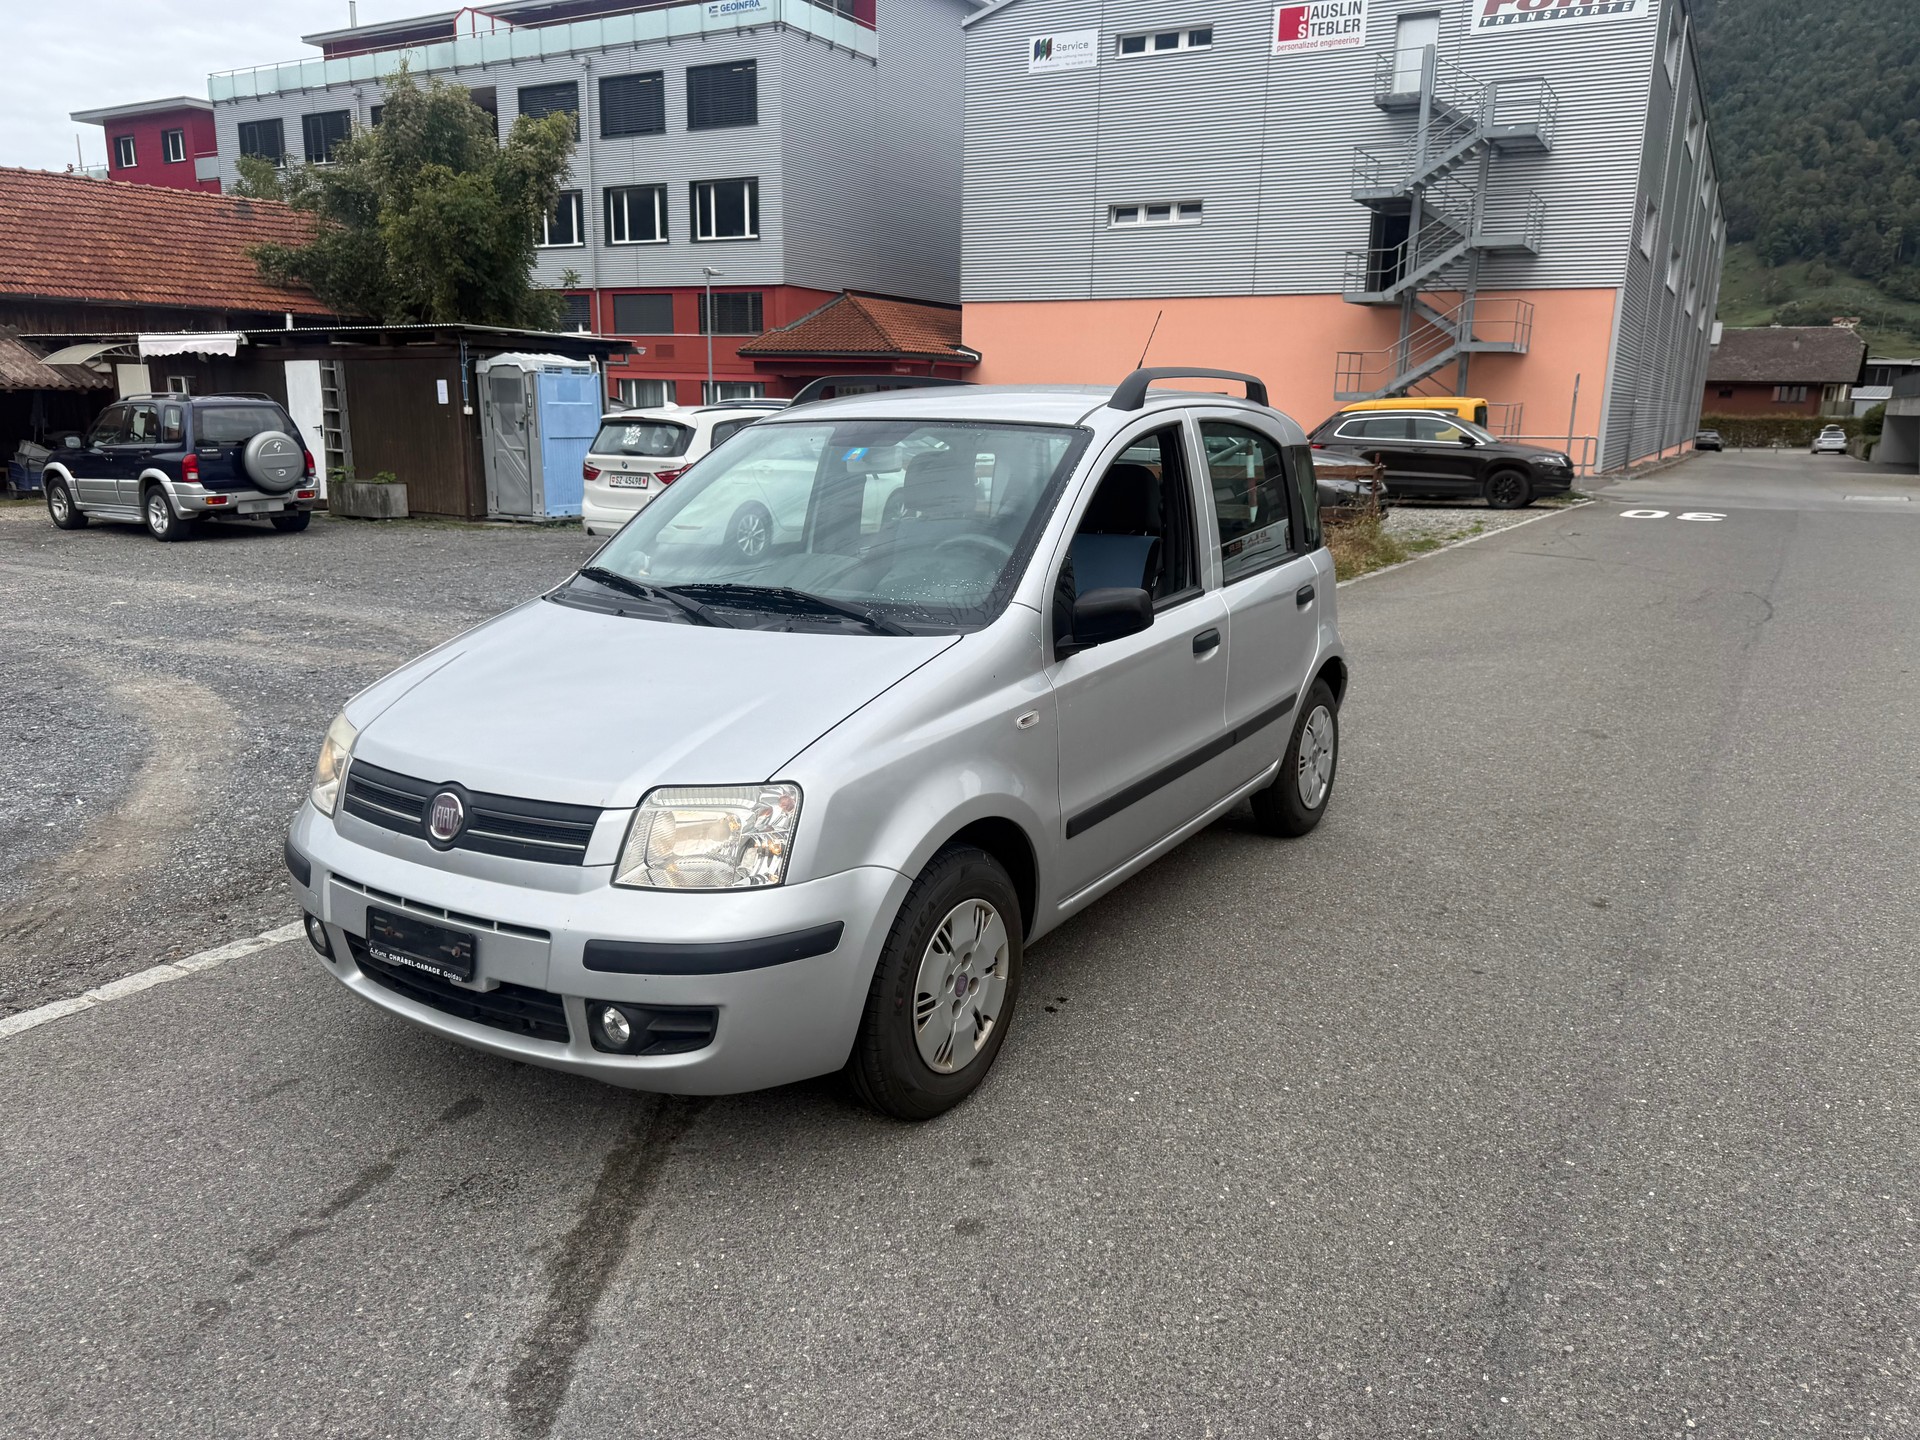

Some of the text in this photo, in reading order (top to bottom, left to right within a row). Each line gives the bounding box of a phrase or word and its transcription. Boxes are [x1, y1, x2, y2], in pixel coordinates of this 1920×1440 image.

[720, 0, 761, 12] GEOINFRA
[1300, 1, 1362, 21] JAUSLIN
[1482, 1, 1632, 26] TRANSPORTE
[1297, 18, 1361, 38] STEBLER
[1276, 36, 1360, 53] personalized engineering
[435, 805, 456, 829] FIAT
[389, 953, 441, 976] CHRÄBEL-GARAGE
[443, 970, 463, 982] Goldau
